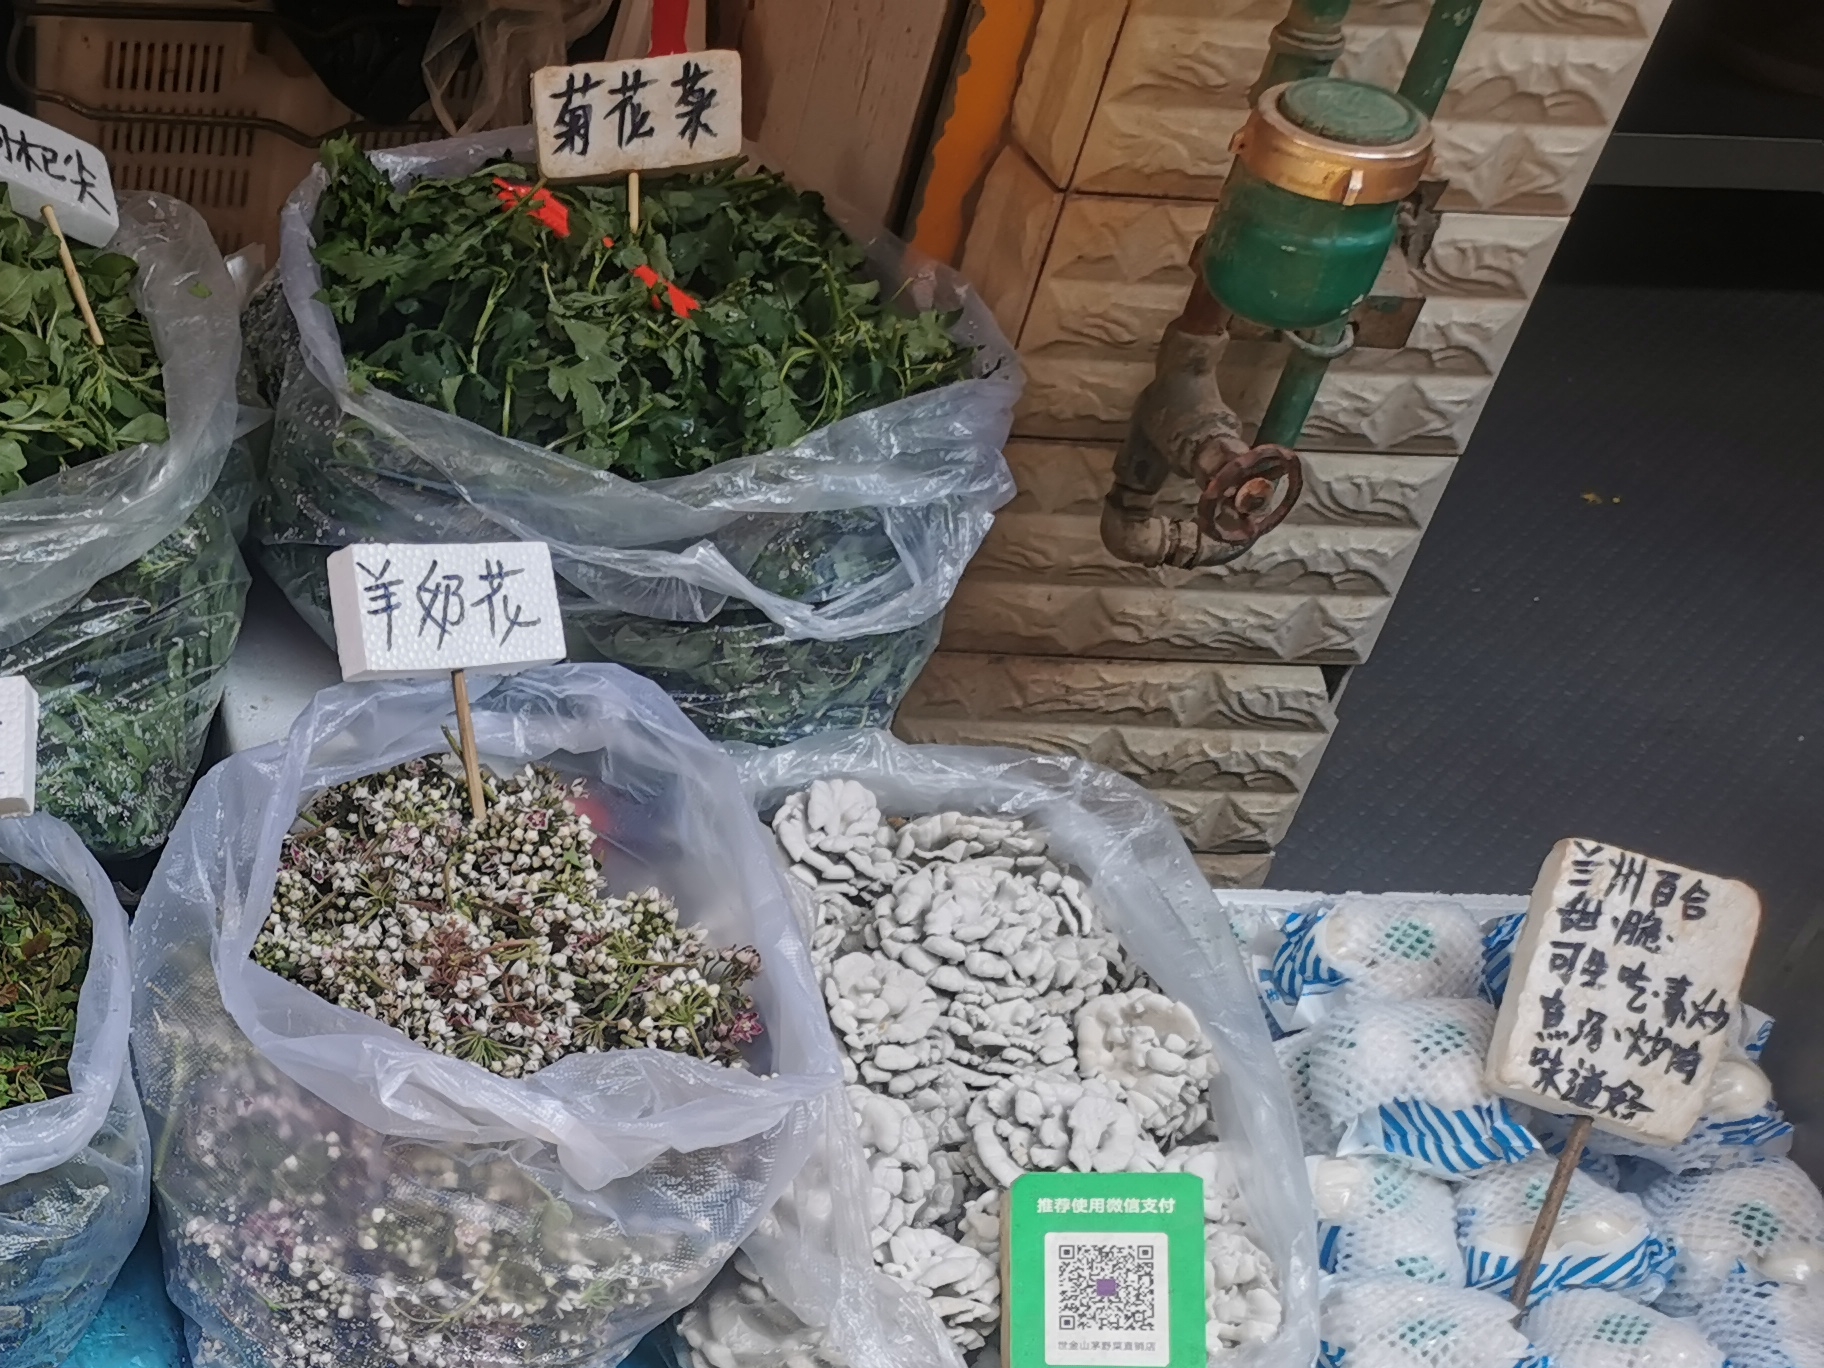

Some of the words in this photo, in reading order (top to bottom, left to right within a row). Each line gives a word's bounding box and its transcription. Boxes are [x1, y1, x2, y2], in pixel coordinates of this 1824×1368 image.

[549, 60, 719, 156] 菊花菜
[356, 559, 541, 652] 羊奶花
[1568, 841, 1710, 921] 兰州百合
[1037, 1198, 1175, 1214] 推荐使用微信支付
